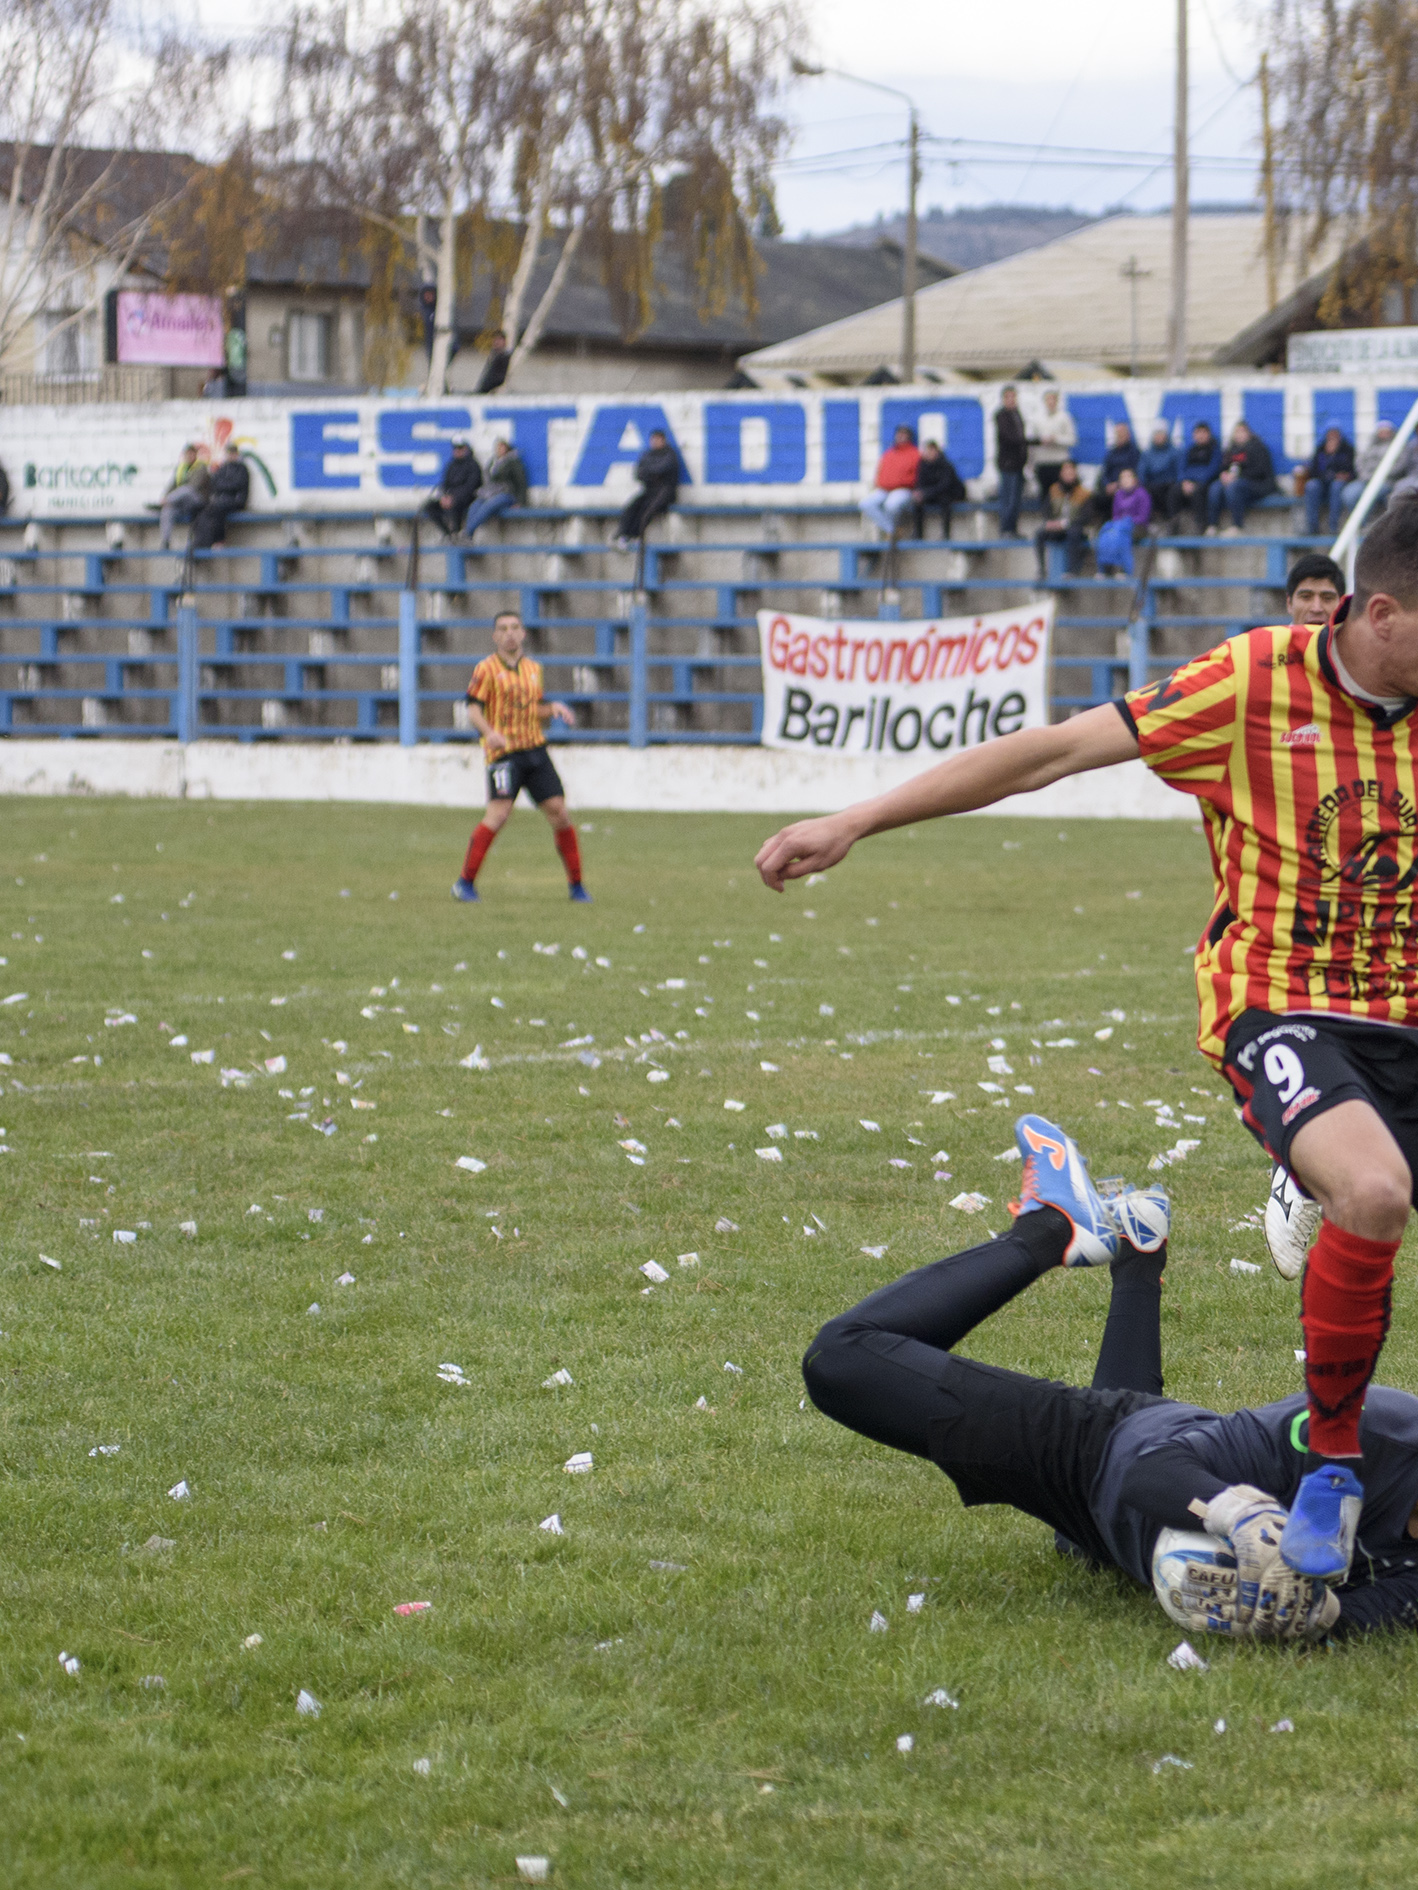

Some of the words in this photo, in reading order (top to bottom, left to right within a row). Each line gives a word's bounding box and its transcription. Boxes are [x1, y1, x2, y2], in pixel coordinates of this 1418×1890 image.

[291, 398, 985, 489] ESTADIO
[768, 616, 1044, 684] Gastronómicos
[780, 686, 1027, 752] Bariloche
[1352, 778, 1383, 801] DEL
[1263, 1043, 1304, 1104] 9
